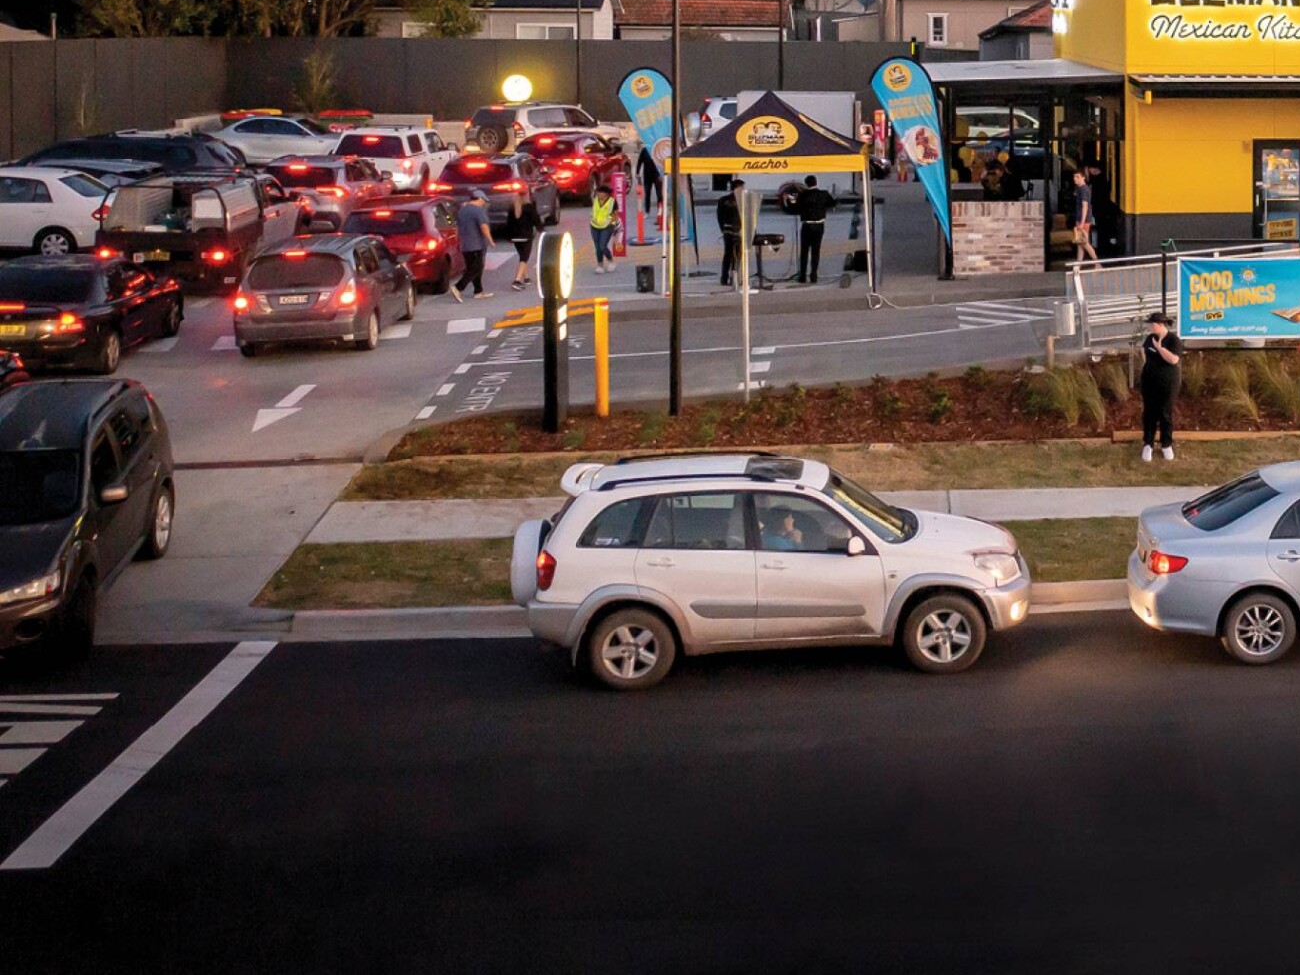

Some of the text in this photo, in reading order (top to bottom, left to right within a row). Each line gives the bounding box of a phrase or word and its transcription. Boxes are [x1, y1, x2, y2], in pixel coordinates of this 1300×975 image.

[1150, 15, 1252, 39] Mexican
[743, 158, 789, 170] nachos
[1190, 270, 1233, 294] GOOD
[1189, 284, 1277, 313] MORNINGS
